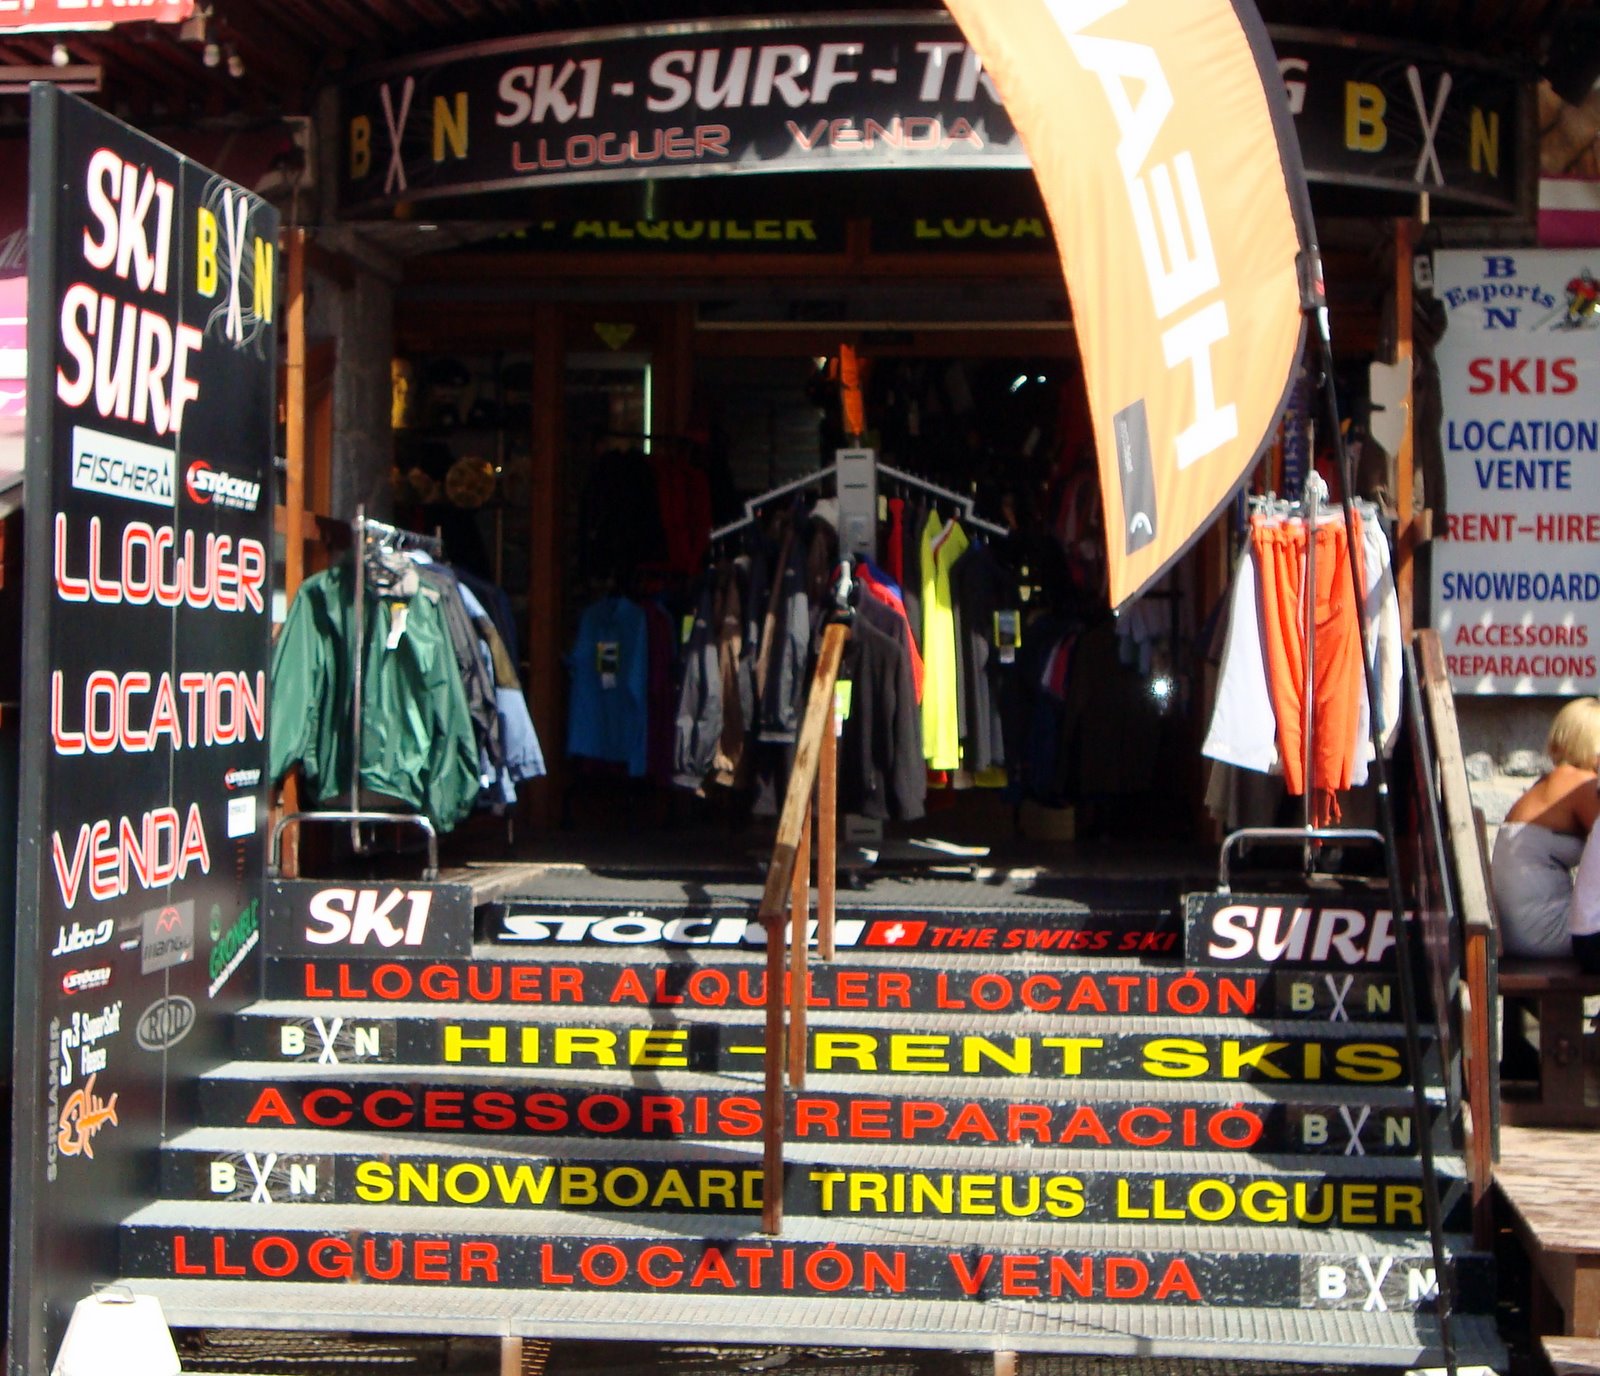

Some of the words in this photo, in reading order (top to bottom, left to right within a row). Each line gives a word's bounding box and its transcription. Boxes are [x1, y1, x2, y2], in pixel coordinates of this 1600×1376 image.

[495, 58, 602, 127] SKI
[646, 42, 863, 113] SURF
[785, 116, 985, 151] VENDA
[83, 147, 174, 295] SKI
[1043, 0, 1239, 471] HEA
[1482, 256, 1516, 278] B
[1444, 283, 1556, 310] Esports
[1483, 307, 1521, 330] N
[57, 282, 203, 436] SURF
[1467, 357, 1578, 396] SKIS
[1447, 420, 1598, 451] LOCATION
[76, 452, 159, 496] FISCHER
[1475, 459, 1572, 490] VENTE
[1442, 572, 1600, 601] SNOWBOARD
[1455, 623, 1589, 648] ACCESSORIS
[1445, 654, 1597, 677] REPARACIONS
[52, 669, 265, 755] LOCATION
[52, 803, 210, 909] VENDA
[305, 887, 433, 948] SKI
[930, 928, 998, 947] THE
[1002, 929, 1112, 950] SWISS
[1118, 931, 1178, 951] SKI
[305, 963, 584, 1003] LLOGUER
[937, 970, 1257, 1015] LOCATIÓN
[444, 1026, 689, 1067] HIRE
[814, 1032, 1104, 1076] RENT
[1142, 1039, 1402, 1082] SKIS
[246, 1087, 763, 1136] ACCESSORIS
[795, 1098, 1263, 1149] REPARACIÓ
[809, 1171, 1085, 1217] TRINEUS
[1117, 1178, 1424, 1226] LLOGUER
[173, 1235, 499, 1282] LLOGUER
[541, 1242, 906, 1292] LOCATIÓN
[949, 1254, 1202, 1300] VENDA
